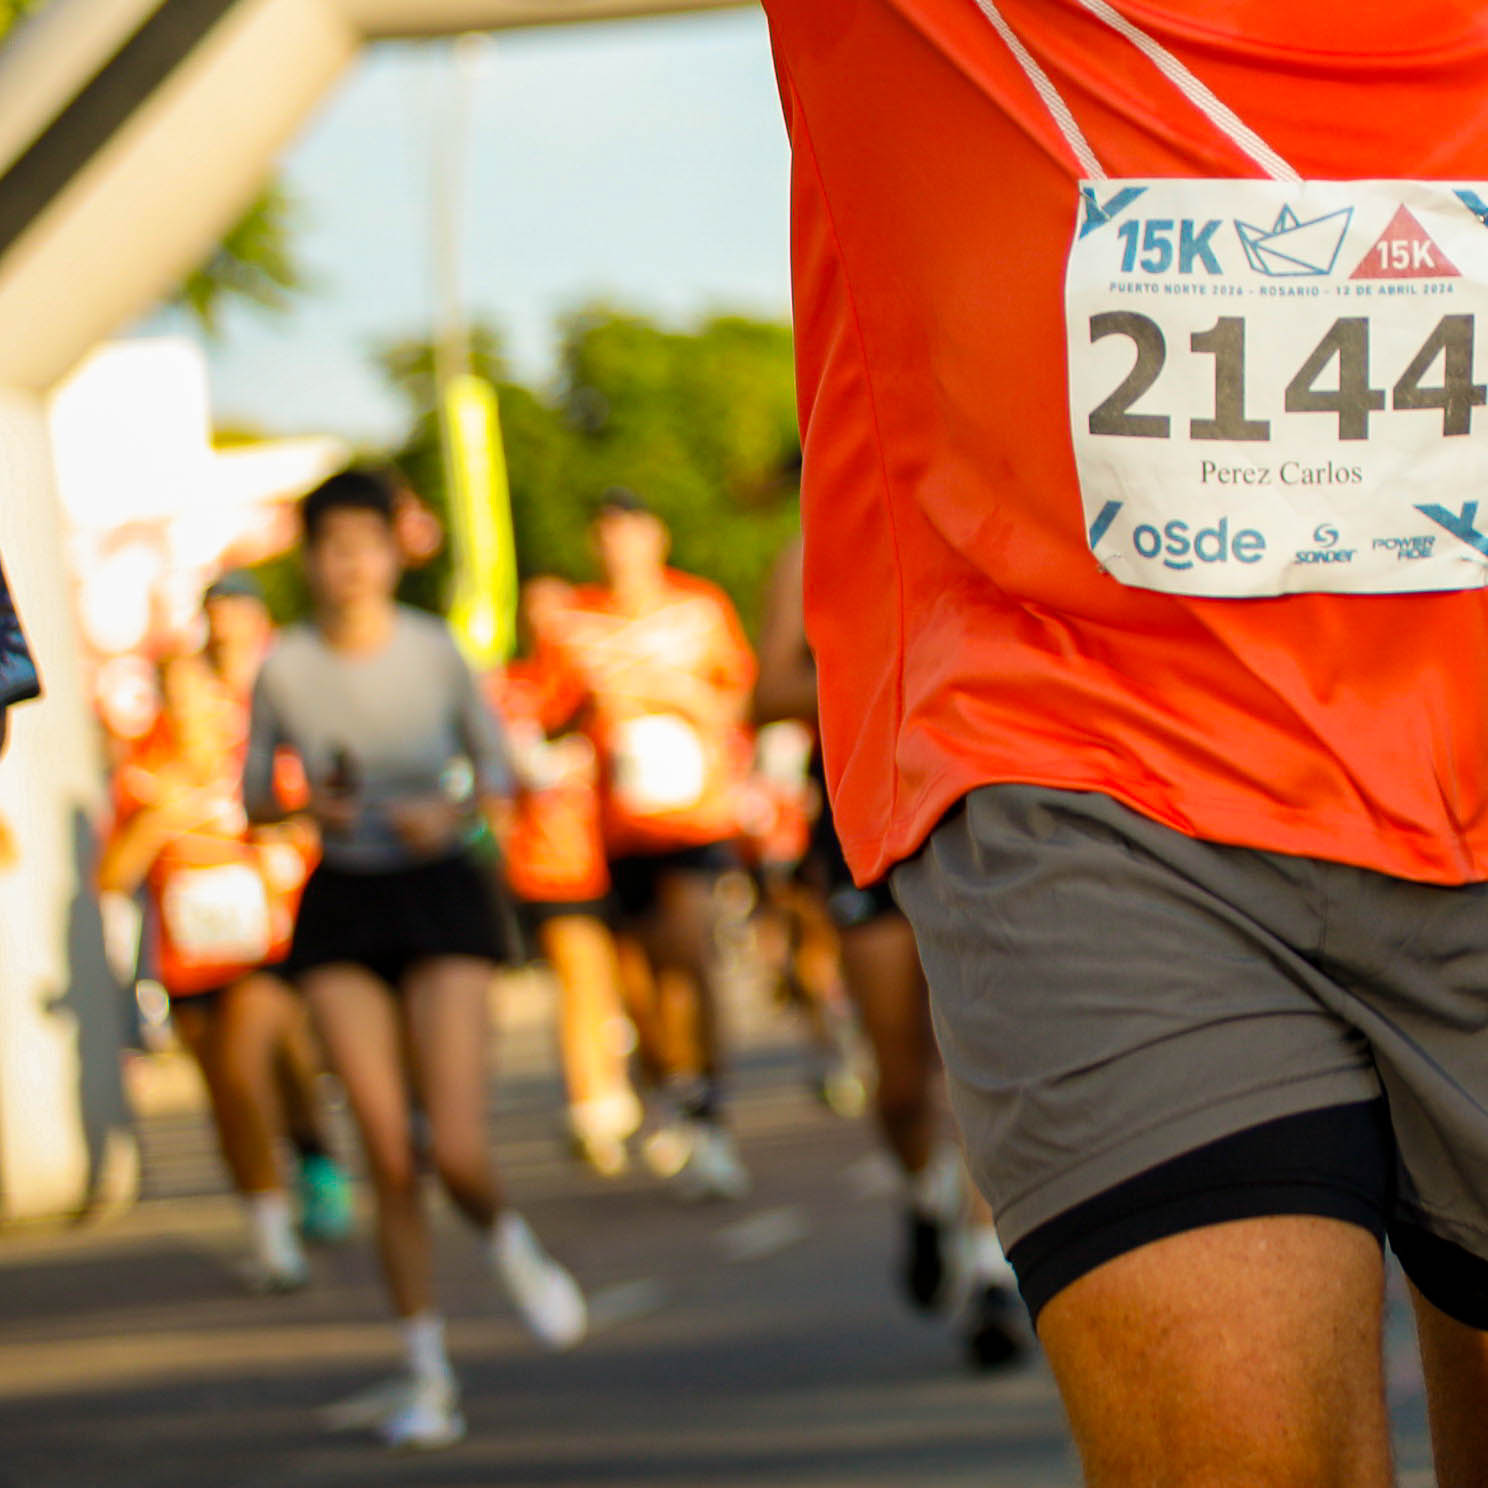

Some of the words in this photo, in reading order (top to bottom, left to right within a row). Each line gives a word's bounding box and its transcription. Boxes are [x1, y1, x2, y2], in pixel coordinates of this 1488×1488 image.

[1116, 218, 1224, 275] 15K
[1376, 240, 1436, 270] 15K
[1109, 282, 1160, 294] PUERTO
[1164, 284, 1207, 295] NORTE
[1260, 285, 1320, 297] ROSARIO
[1356, 285, 1372, 296] DE
[1378, 284, 1416, 295] ABRIL
[1088, 310, 1488, 442] 2144
[1200, 460, 1272, 485] Perez
[1279, 460, 1363, 486] Carlos
[1133, 516, 1266, 565] osde
